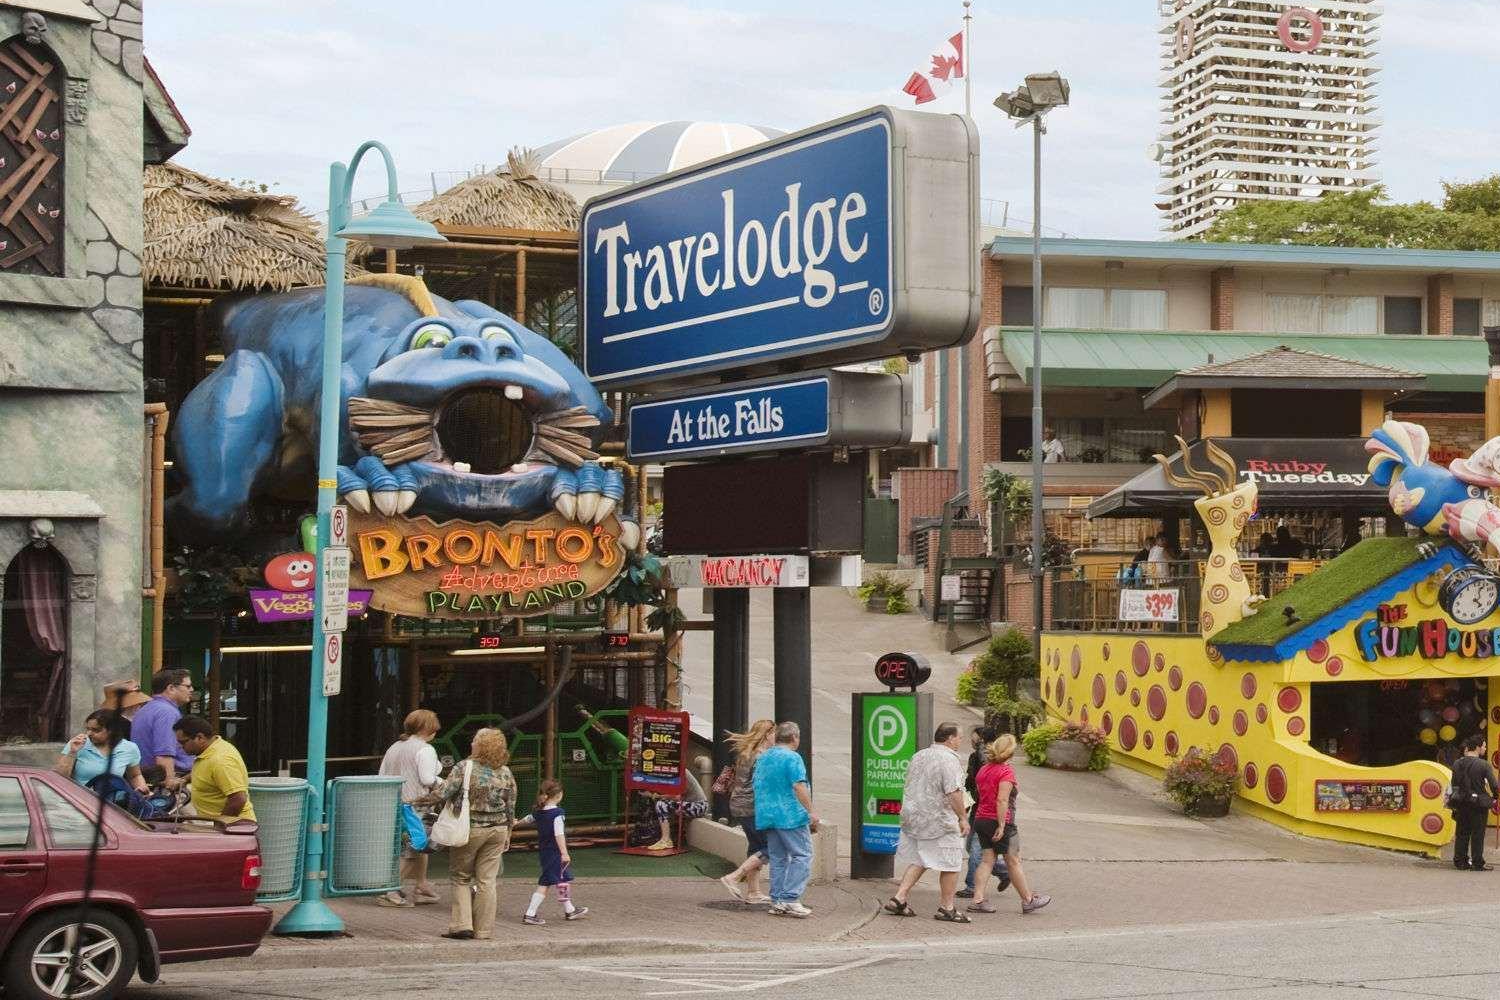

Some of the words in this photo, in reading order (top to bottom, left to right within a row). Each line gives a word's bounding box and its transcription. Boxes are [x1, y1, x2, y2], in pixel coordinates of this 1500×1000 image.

[595, 182, 868, 318] Travelodge
[667, 409, 693, 444] At
[695, 405, 730, 440] the
[734, 397, 784, 438] Falls
[1240, 470, 1372, 486] Tuesday
[1246, 459, 1327, 475] Ruby
[357, 524, 620, 582] BRONTO'S
[439, 559, 582, 594] Adventure
[701, 558, 787, 586] VACANCY
[426, 580, 588, 614] PLAYLAND
[1377, 603, 1408, 624] THE
[651, 733, 672, 744] BIG
